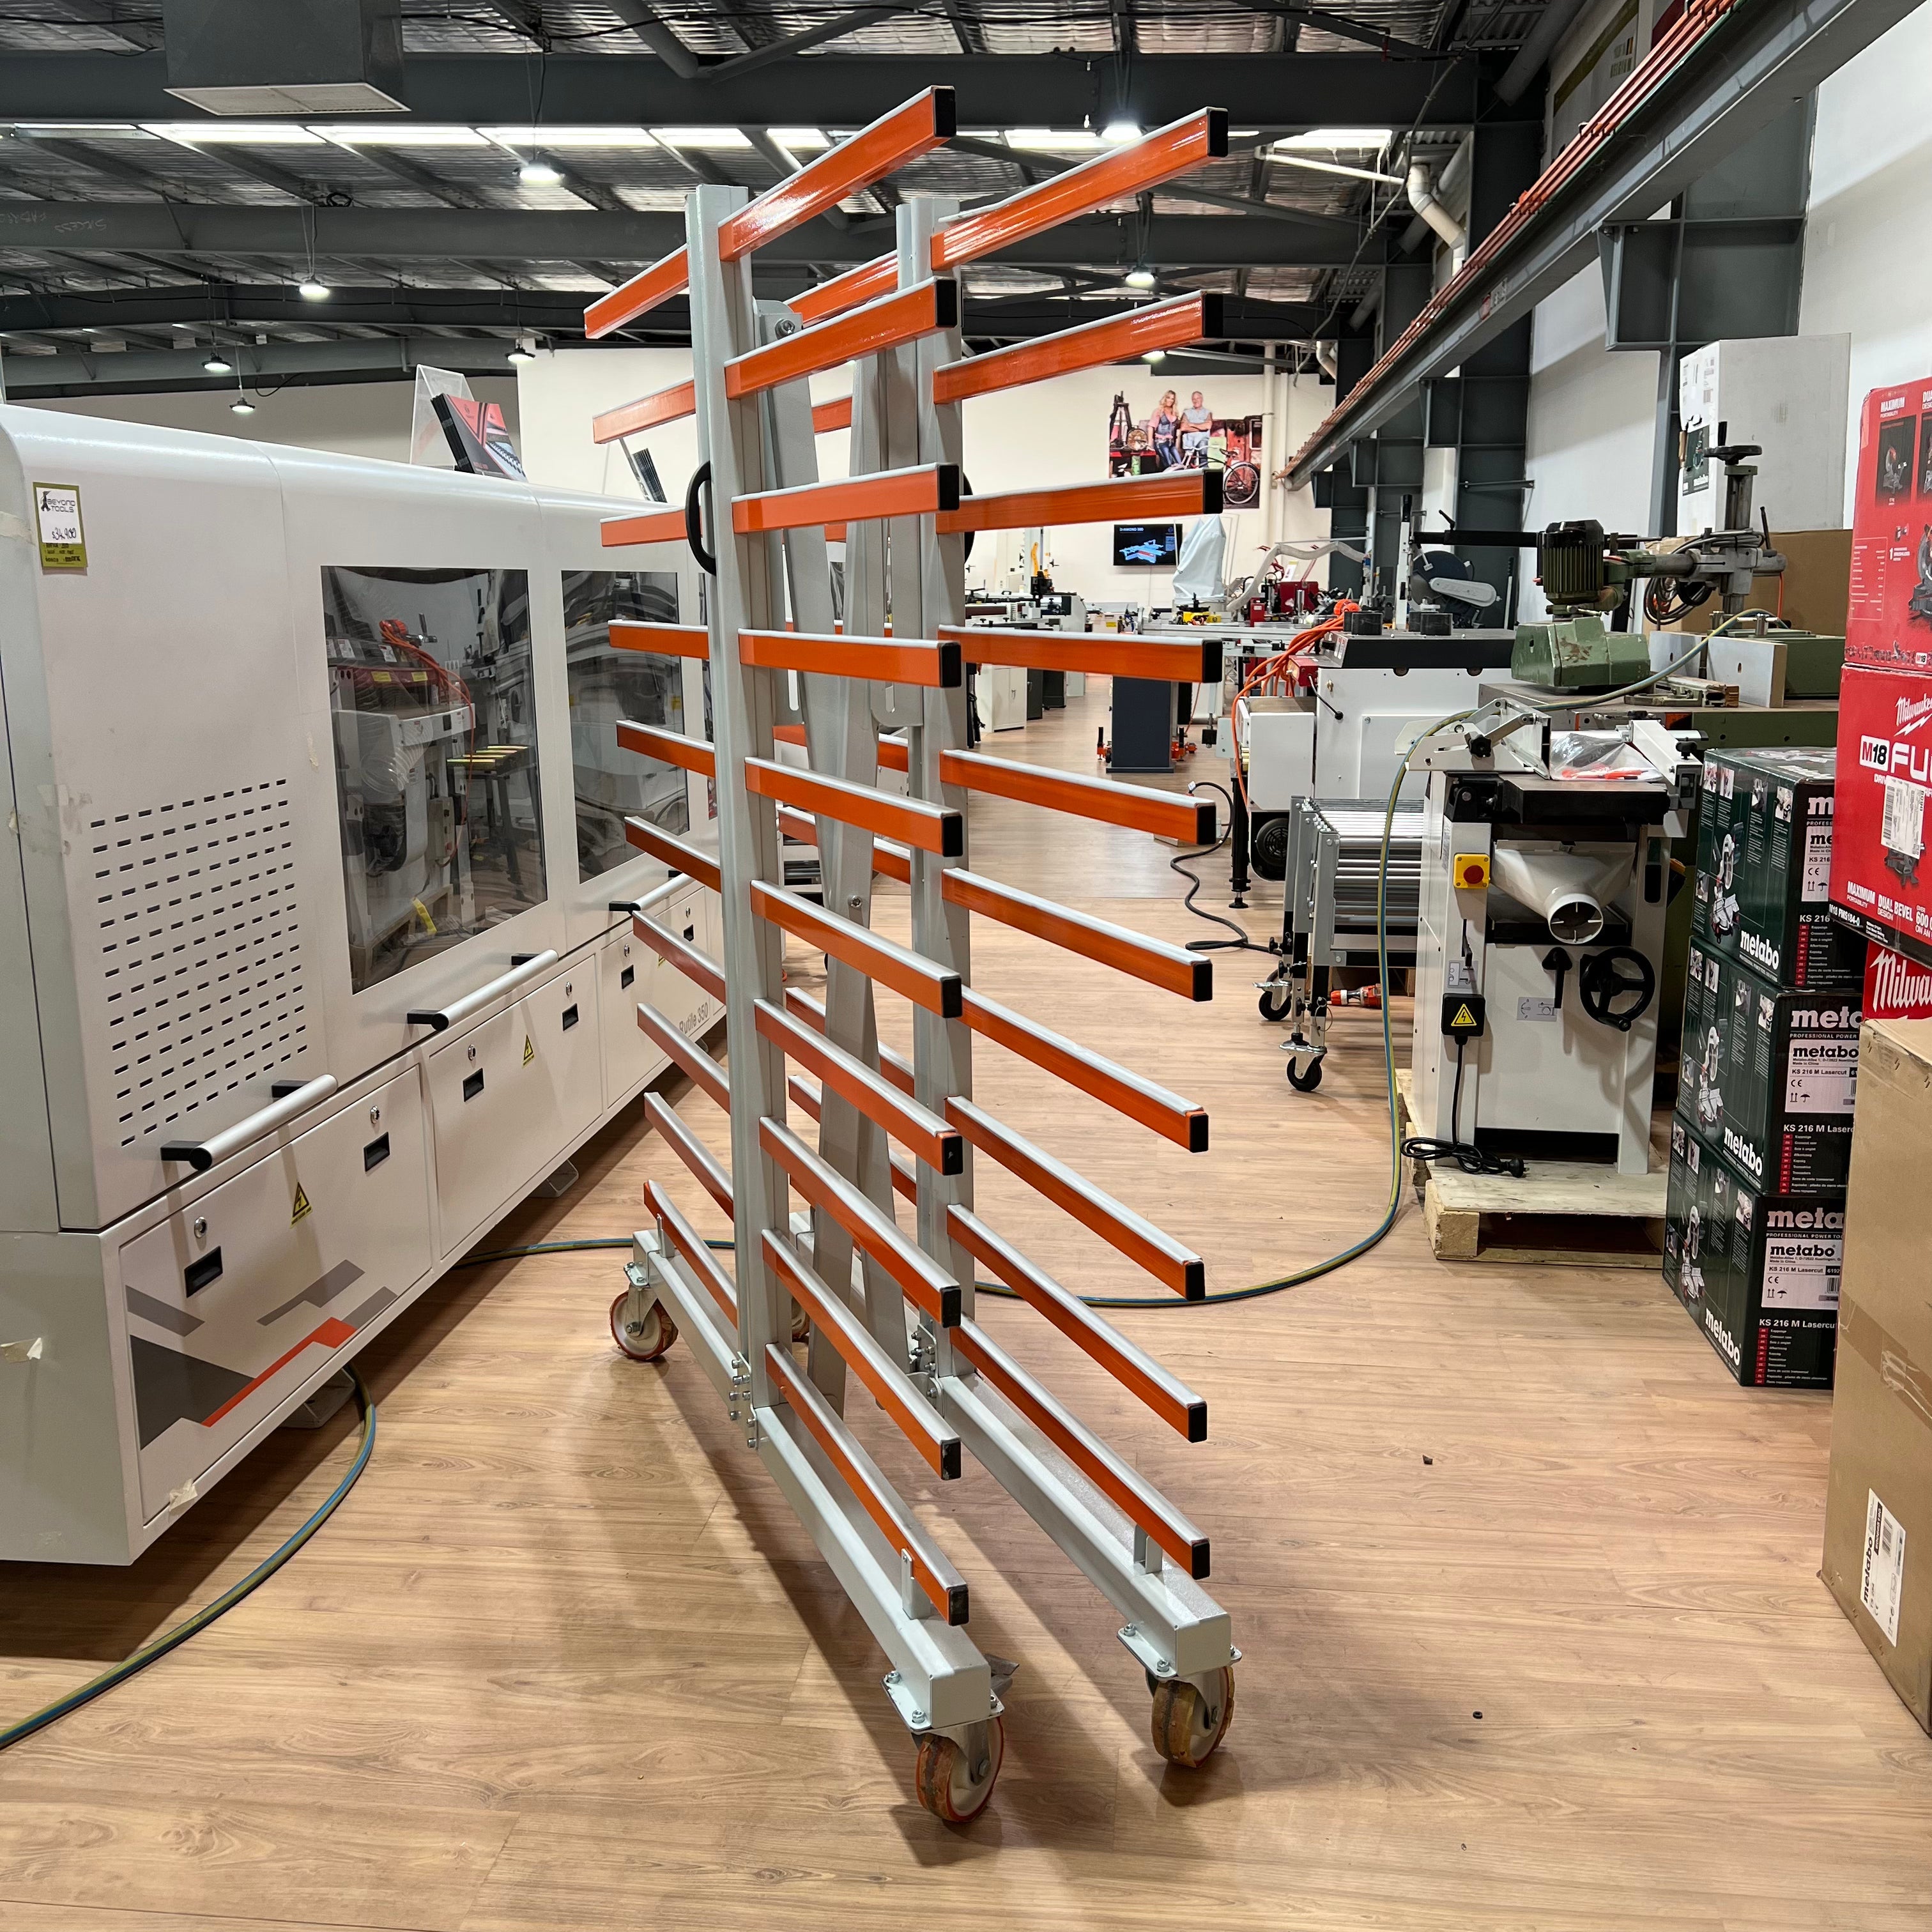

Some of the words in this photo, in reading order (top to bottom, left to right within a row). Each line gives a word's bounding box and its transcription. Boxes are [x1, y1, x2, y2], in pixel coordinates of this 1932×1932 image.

[1880, 397, 1905, 413] MAXIMUM
[47, 498, 75, 507] BEYOND
[1862, 740, 1887, 765] M18
[1890, 742, 1932, 783] FU
[1847, 880, 1876, 905] MAXIMUM
[1877, 907, 1894, 921] DESIGN
[1878, 894, 1894, 913] DUAL
[1894, 900, 1913, 922] BEVEL
[1799, 914, 1813, 923] KS
[1814, 914, 1830, 923] 216
[1915, 911, 1929, 928] 600
[1915, 924, 1923, 935] ON
[1740, 930, 1779, 970] metabo
[679, 1013, 697, 1034] Rutile
[698, 1002, 709, 1023] 350
[1793, 1045, 1859, 1058] metabo
[1783, 1124, 1796, 1132] KS
[1798, 1124, 1814, 1133] 216
[1816, 1124, 1825, 1133] M
[1724, 1127, 1763, 1176] metabo
[1770, 1245, 1835, 1257] metabo
[1705, 1308, 1740, 1366] metabo
[1864, 1537, 1873, 1604] metabo
